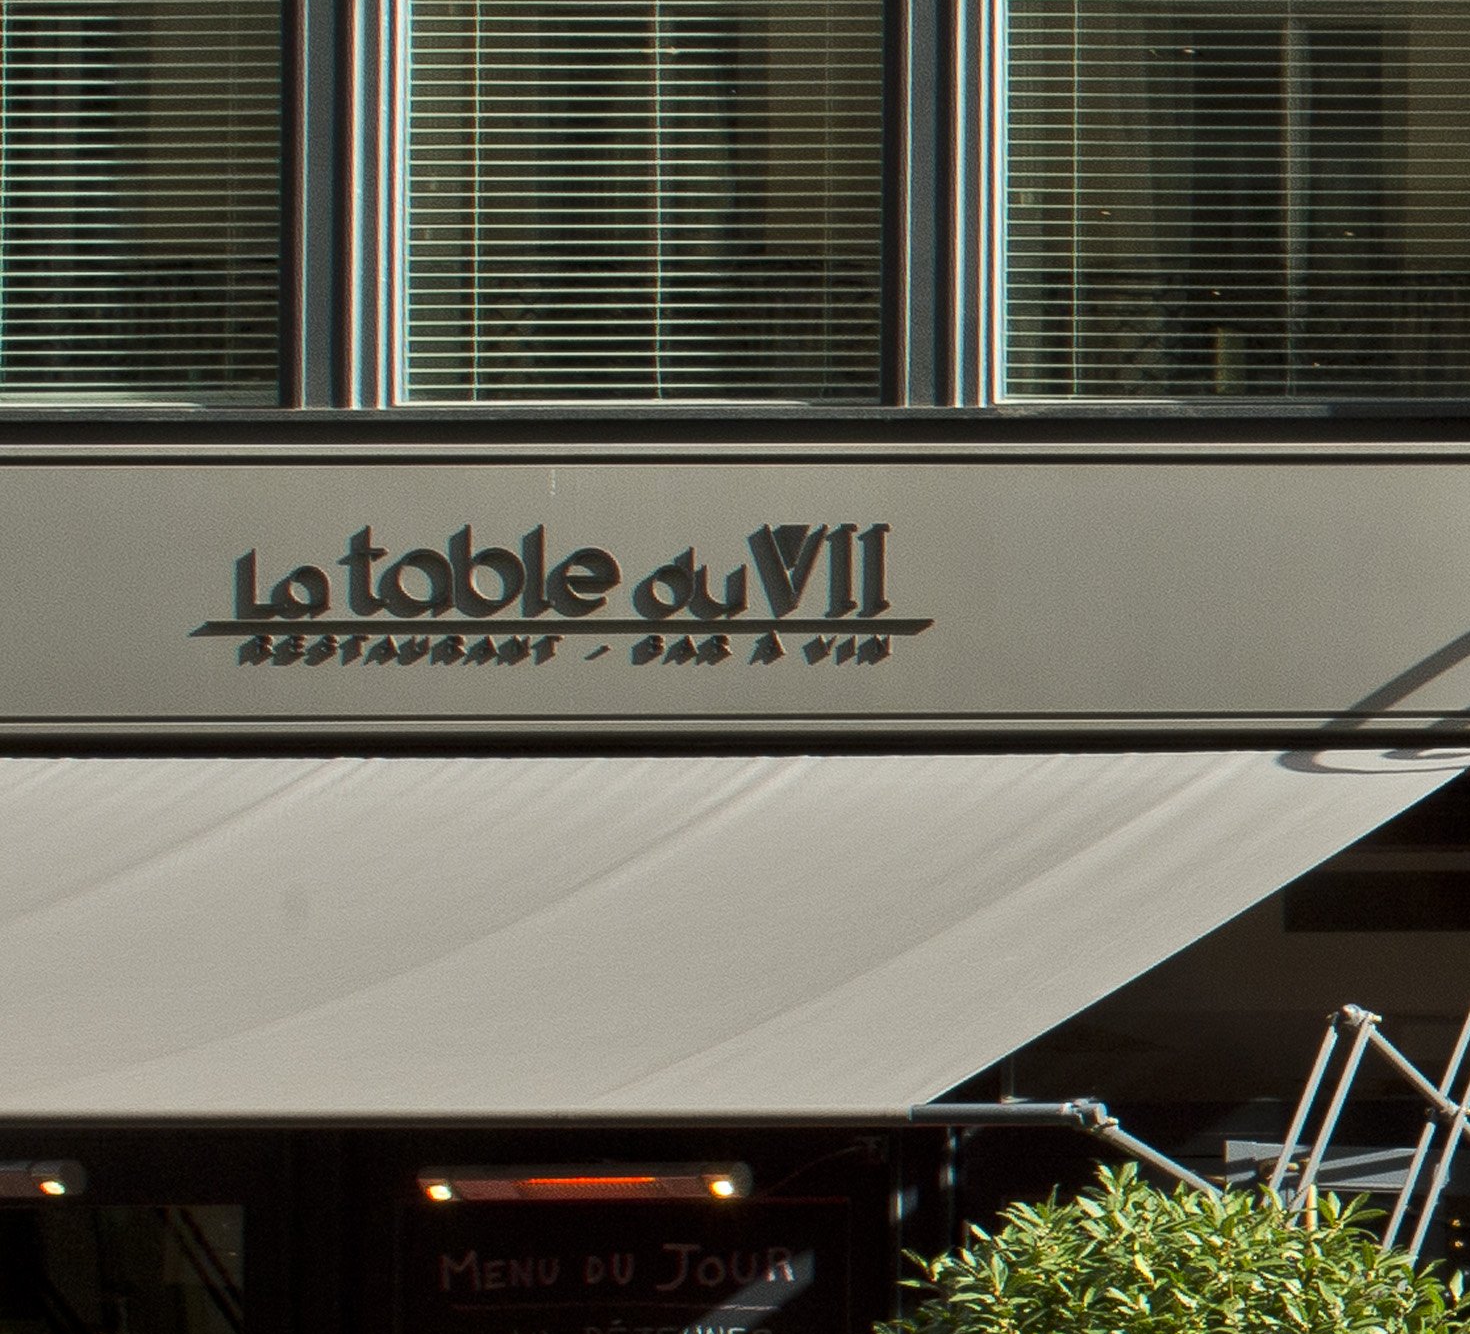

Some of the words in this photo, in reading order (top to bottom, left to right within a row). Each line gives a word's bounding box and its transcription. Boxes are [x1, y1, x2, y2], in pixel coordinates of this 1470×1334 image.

[233, 547, 331, 620] La
[338, 524, 622, 619] table
[631, 546, 749, 620] du
[748, 523, 892, 619] VII
[238, 633, 563, 667] RESTAURANT
[632, 633, 732, 666] BAR
[803, 633, 893, 666] VIN
[437, 1248, 561, 1293] MENU
[582, 1252, 636, 1286] DU
[655, 1241, 796, 1293] JOUR
